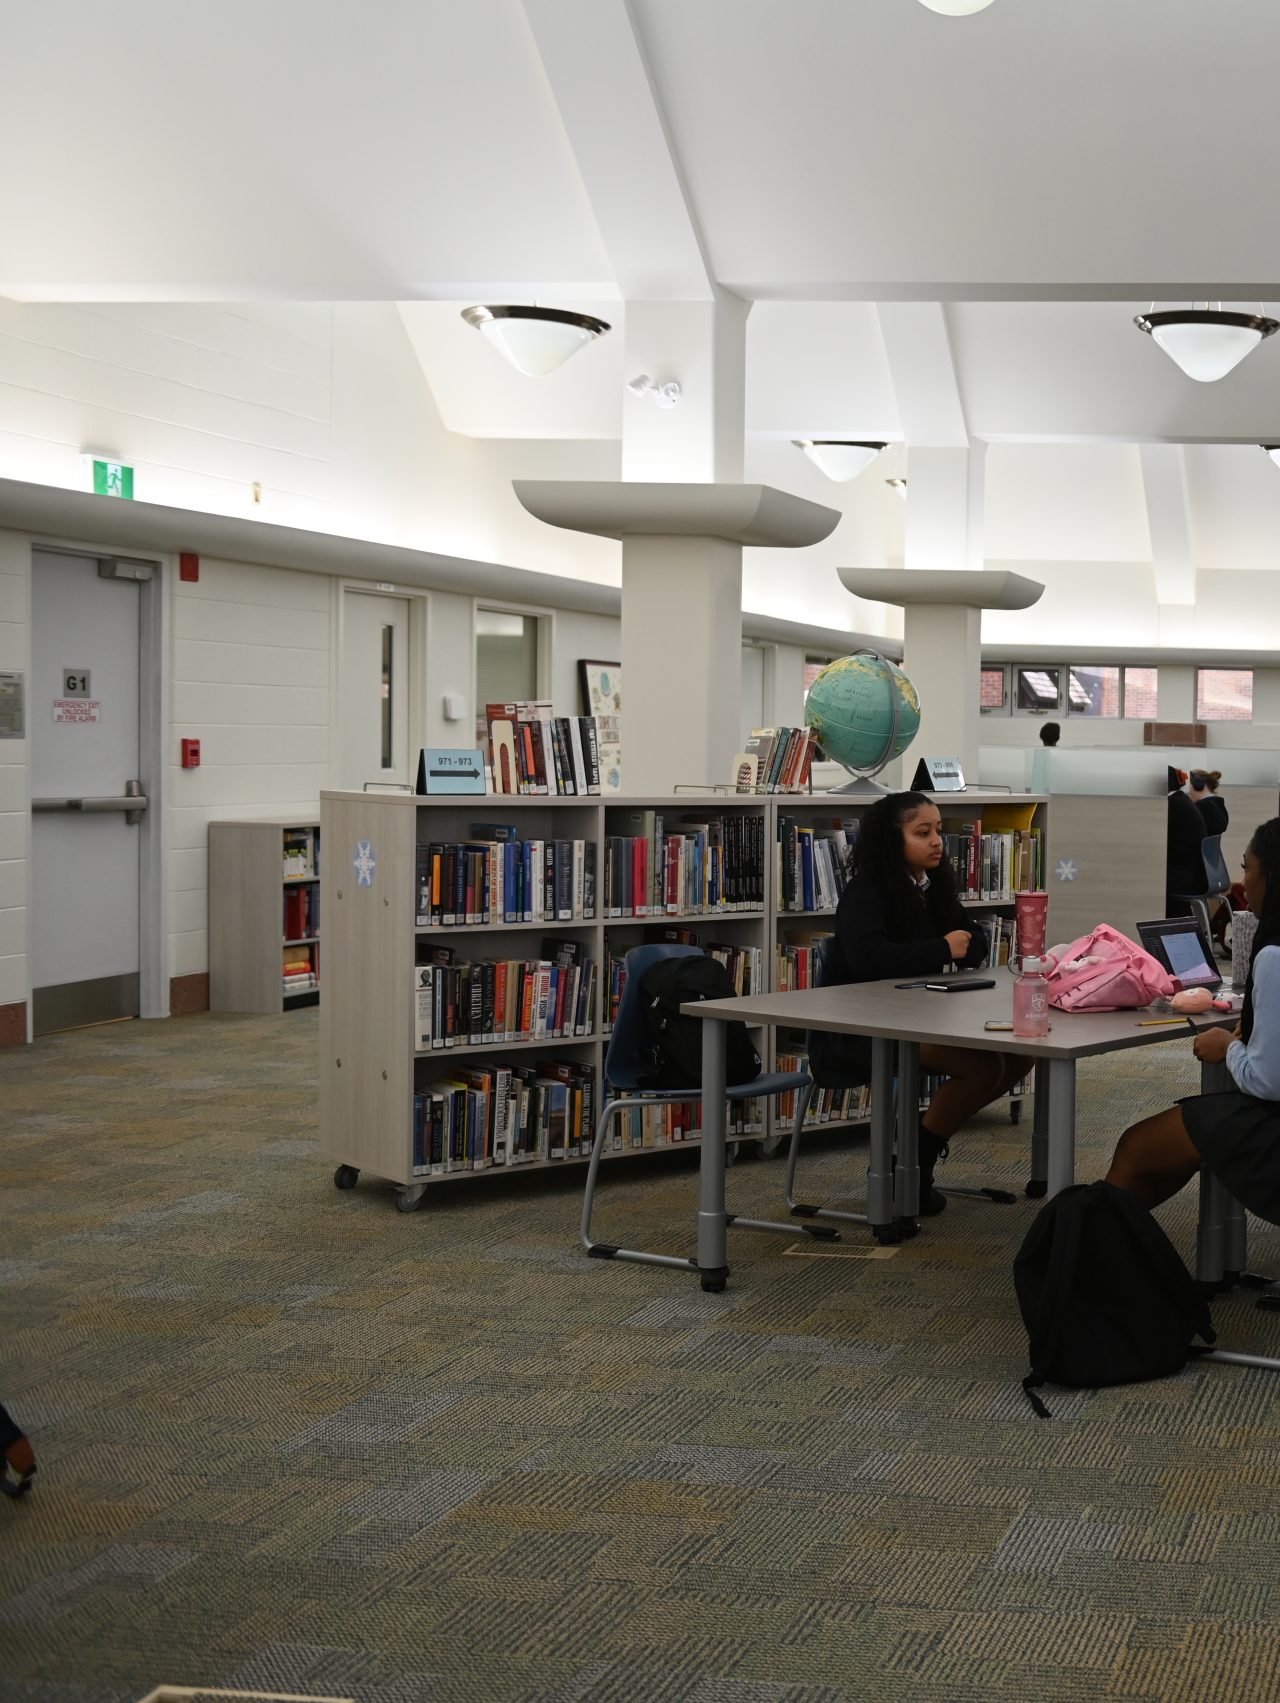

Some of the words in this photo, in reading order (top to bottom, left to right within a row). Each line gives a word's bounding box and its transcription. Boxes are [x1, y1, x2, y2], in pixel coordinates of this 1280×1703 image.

[438, 757, 452, 766] 971
[459, 757, 472, 766] 973
[540, 976, 550, 998] DOUBLE
[538, 1000, 548, 1020] VISION
[498, 1073, 506, 1100] BRITISH
[496, 1102, 504, 1140] COLUMBIA
